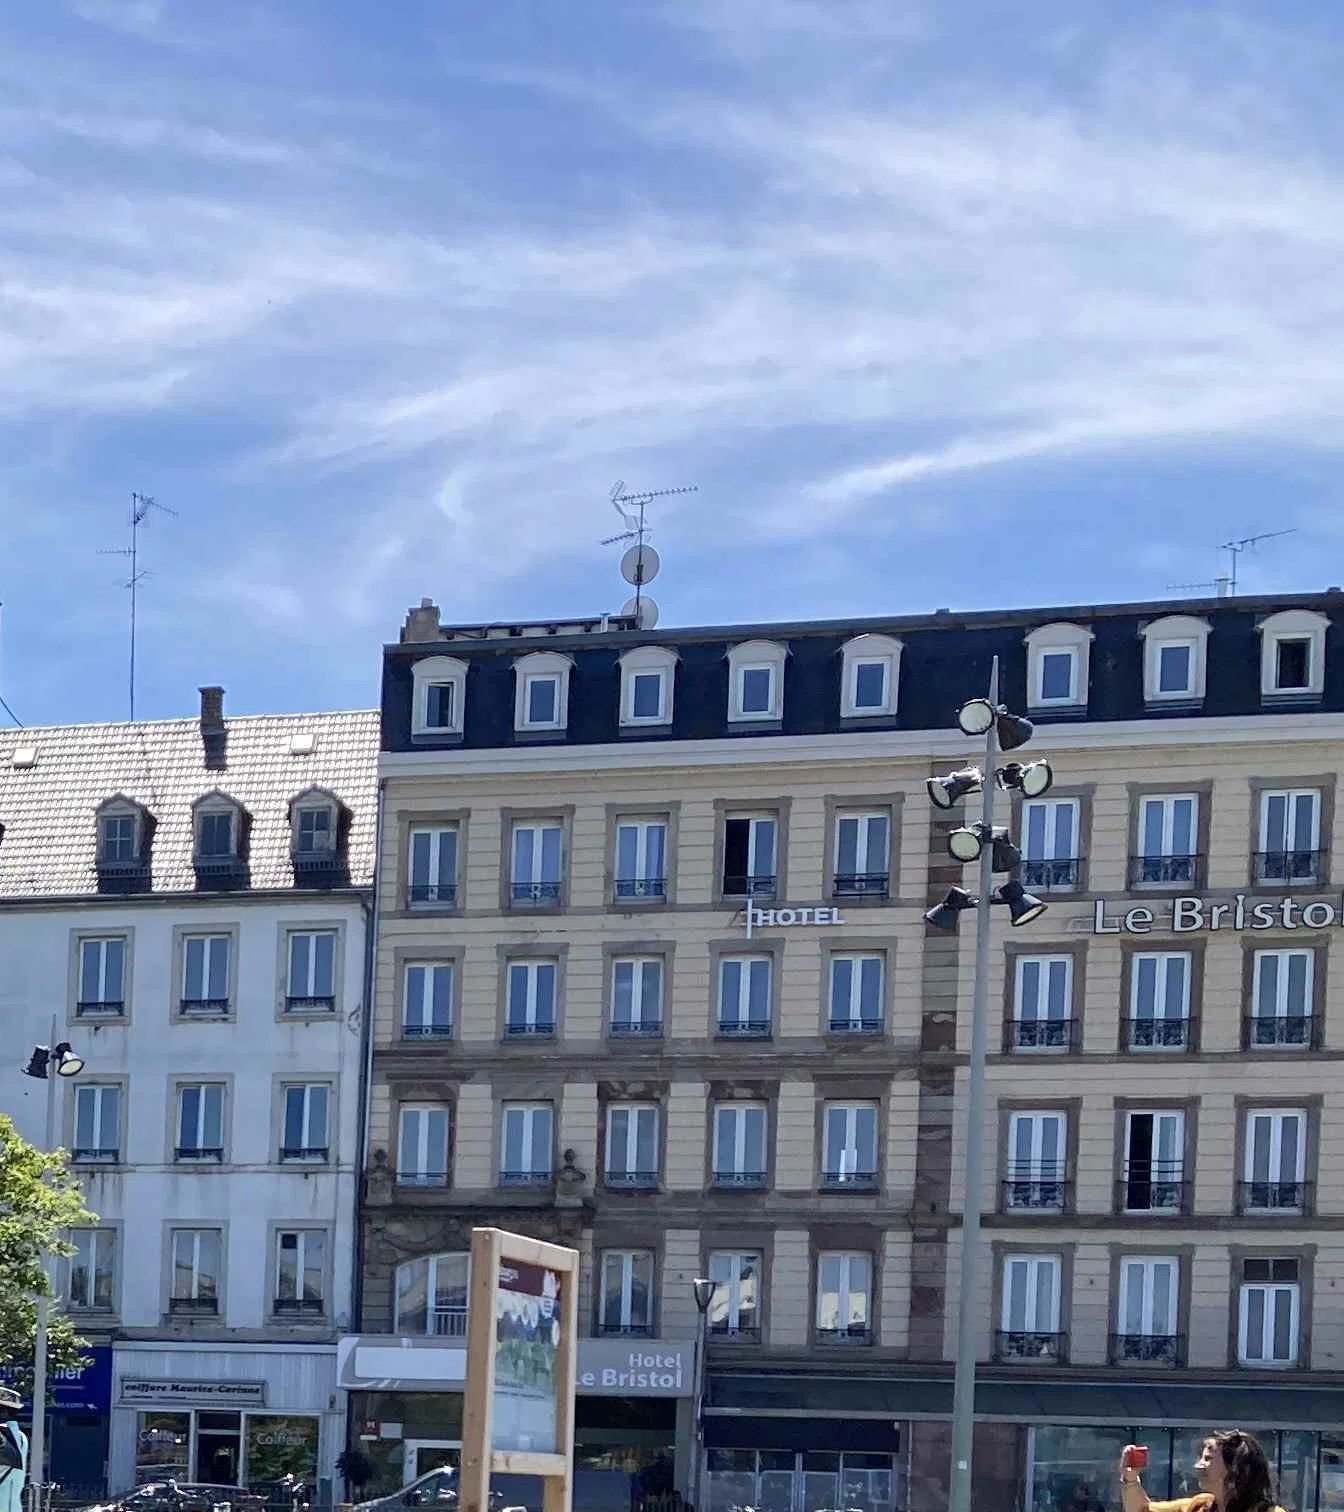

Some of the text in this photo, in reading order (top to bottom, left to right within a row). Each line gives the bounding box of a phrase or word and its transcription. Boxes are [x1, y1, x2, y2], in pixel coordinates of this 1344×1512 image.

[755, 907, 846, 927] HOTEL
[1094, 894, 1344, 934] Le Bristo
[629, 1352, 682, 1369] Hotel
[574, 1368, 683, 1388] e Bristol
